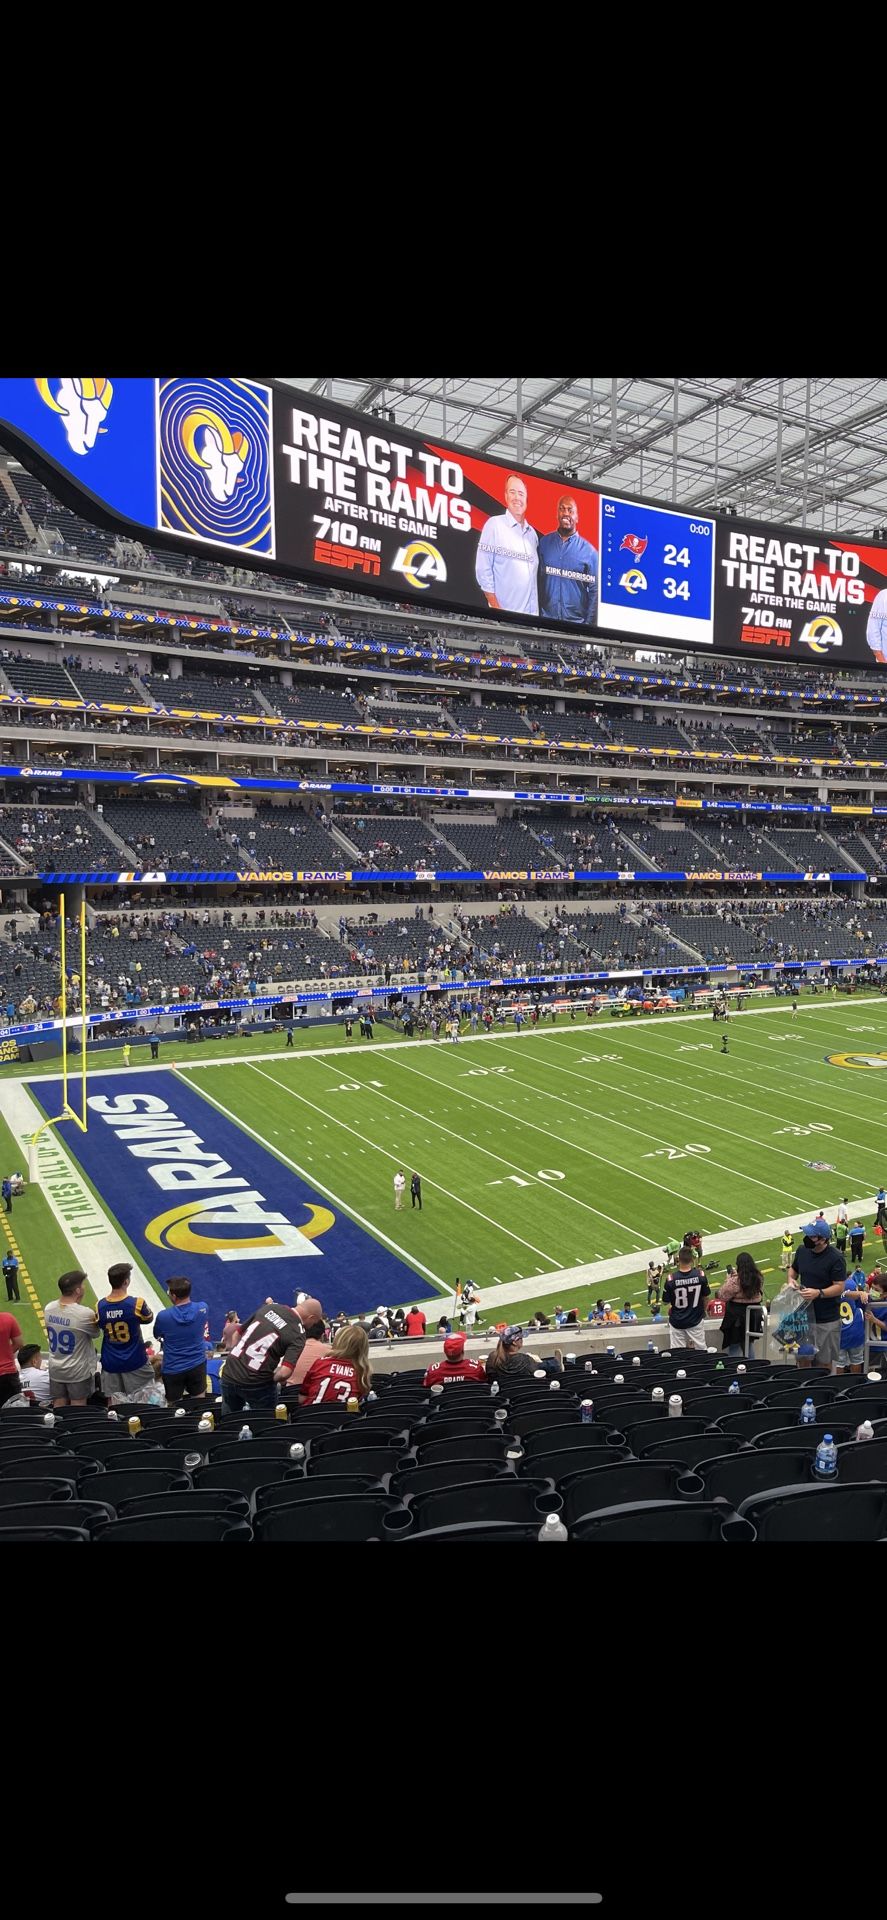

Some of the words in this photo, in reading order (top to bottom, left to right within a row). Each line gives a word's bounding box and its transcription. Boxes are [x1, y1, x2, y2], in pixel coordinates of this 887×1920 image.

[292, 408, 412, 480] REACT
[418, 451, 464, 496] TO
[282, 444, 356, 501] THE
[367, 471, 472, 532] RAMS
[324, 497, 368, 521] AFTER
[370, 509, 396, 529] THE
[398, 518, 437, 539] GAME
[604, 503, 616, 515] Q4
[689, 523, 710, 536] 0:00
[313, 515, 358, 547] 710
[360, 536, 382, 552] AM
[313, 539, 381, 577] ESPN
[478, 543, 502, 555] TRAVIS
[663, 543, 691, 568] 24
[729, 532, 819, 571] REACT
[824, 548, 860, 577] TO
[391, 543, 447, 586] LA
[545, 566, 561, 576] KIRK
[562, 570, 596, 583] MORRISON
[619, 571, 647, 592] LA
[663, 577, 691, 601] 34
[721, 559, 776, 593] THE
[782, 569, 865, 605] RAMS
[750, 593, 783, 607] AFTER
[784, 598, 804, 610] THE
[806, 600, 837, 614] GAME
[741, 607, 775, 628] 710
[775, 617, 792, 629] AM
[741, 625, 791, 647] ESPN
[798, 619, 843, 649] LA
[34, 769, 63, 777] RAMS
[380, 785, 394, 793] 0:00
[236, 872, 294, 881] VAMOS
[303, 872, 347, 880] RAMS
[483, 872, 528, 880] VAMOS
[536, 872, 570, 880] RAMS
[685, 872, 722, 880] VAMOS
[728, 872, 757, 880] RAMS
[2, 1039, 16, 1048] OS
[467, 1065, 514, 1076] 20
[339, 1079, 389, 1091] 10
[783, 1122, 834, 1136] 30
[87, 1093, 251, 1191] RAMS
[655, 1143, 712, 1160] 20
[38, 1160, 73, 1180] ALL
[502, 1169, 566, 1187] 10
[48, 1182, 97, 1222] TAKES
[70, 1225, 108, 1239] IT
[165, 1190, 326, 1262] LA
[674, 1284, 702, 1309] 87
[106, 1310, 124, 1319] KUPP
[713, 1304, 723, 1314] 12
[840, 1301, 854, 1325] 9
[48, 1314, 71, 1327] DONALD
[264, 1310, 288, 1330] GODWIN
[46, 1325, 76, 1355] 99
[105, 1321, 131, 1344] 18
[230, 1321, 279, 1371] 14
[329, 1363, 355, 1377] EVANS
[468, 1358, 479, 1369] 12
[443, 1375, 465, 1383] BRADY
[311, 1377, 352, 1404] 13
